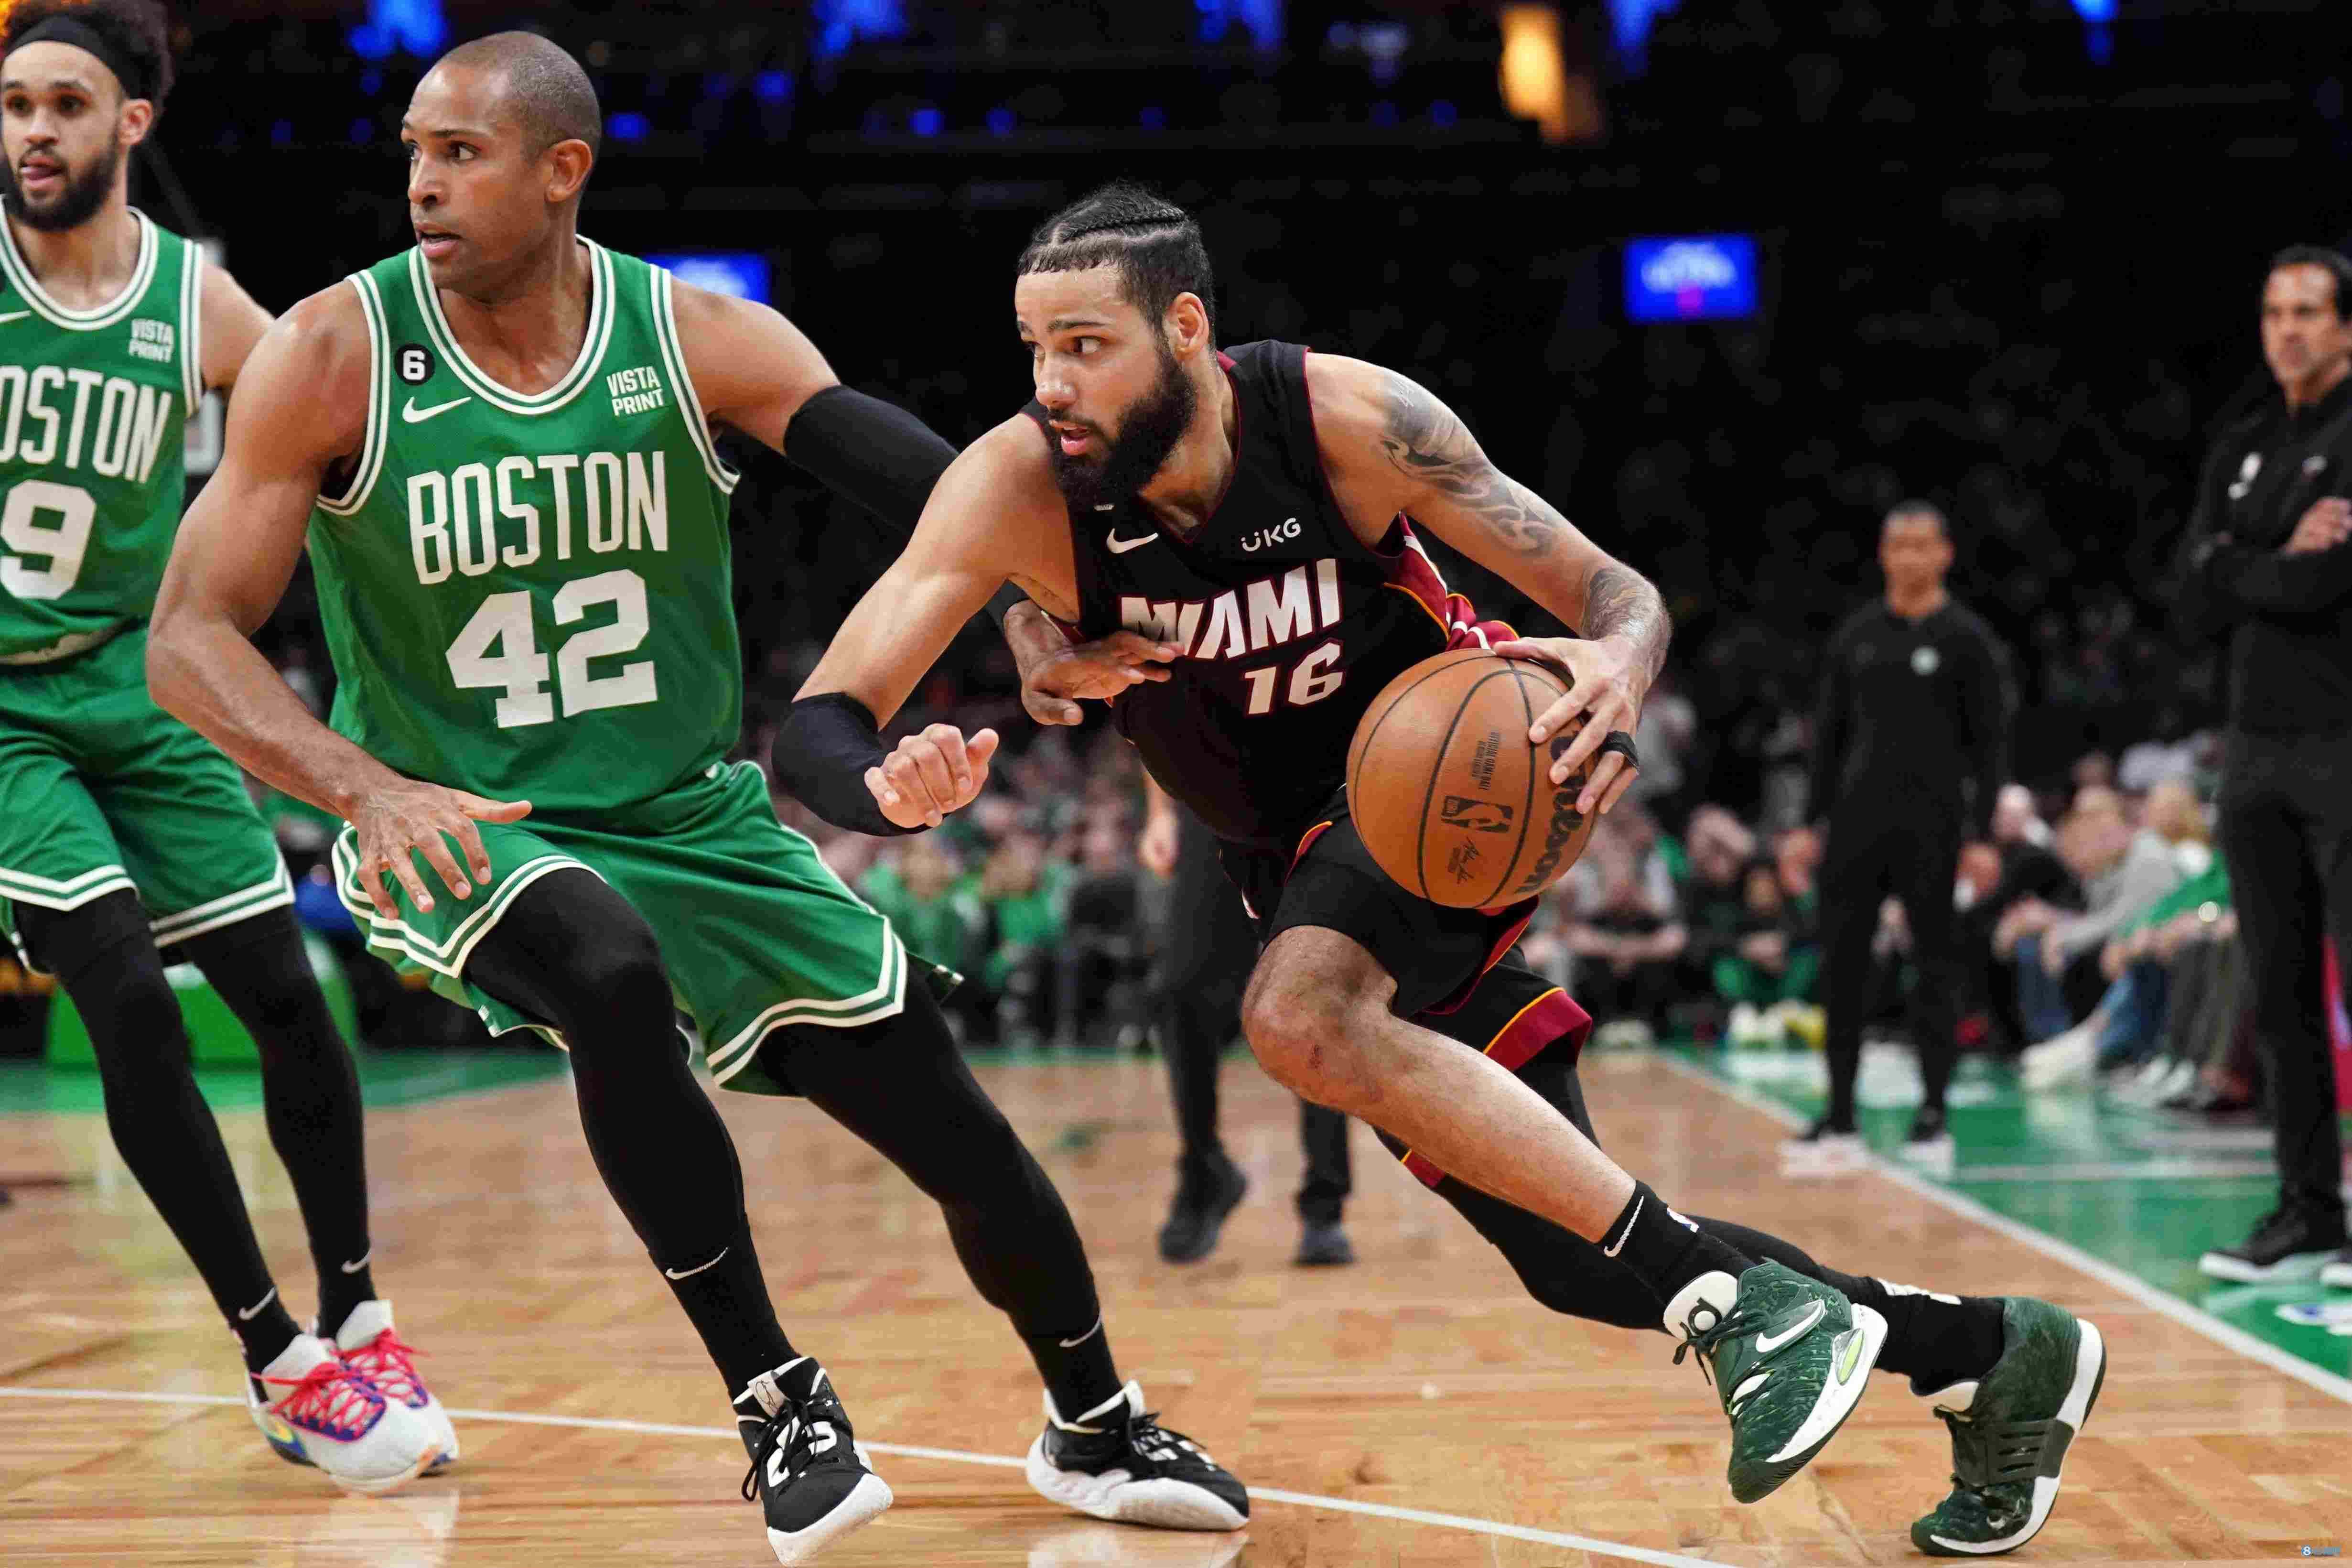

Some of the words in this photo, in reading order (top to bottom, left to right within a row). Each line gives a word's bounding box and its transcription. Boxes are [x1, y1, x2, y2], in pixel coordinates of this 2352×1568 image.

[128, 342, 174, 363] PRINT
[130, 319, 174, 345] VISTA
[403, 350, 424, 379] 6
[606, 366, 661, 397] VISTA
[611, 388, 664, 416] PRINT
[0, 366, 173, 484] OSTON
[0, 479, 97, 600] 9
[407, 451, 668, 584] BOSTON
[1120, 558, 1341, 659] MIAMI
[445, 568, 658, 728] 42
[1245, 643, 1343, 715] 16
